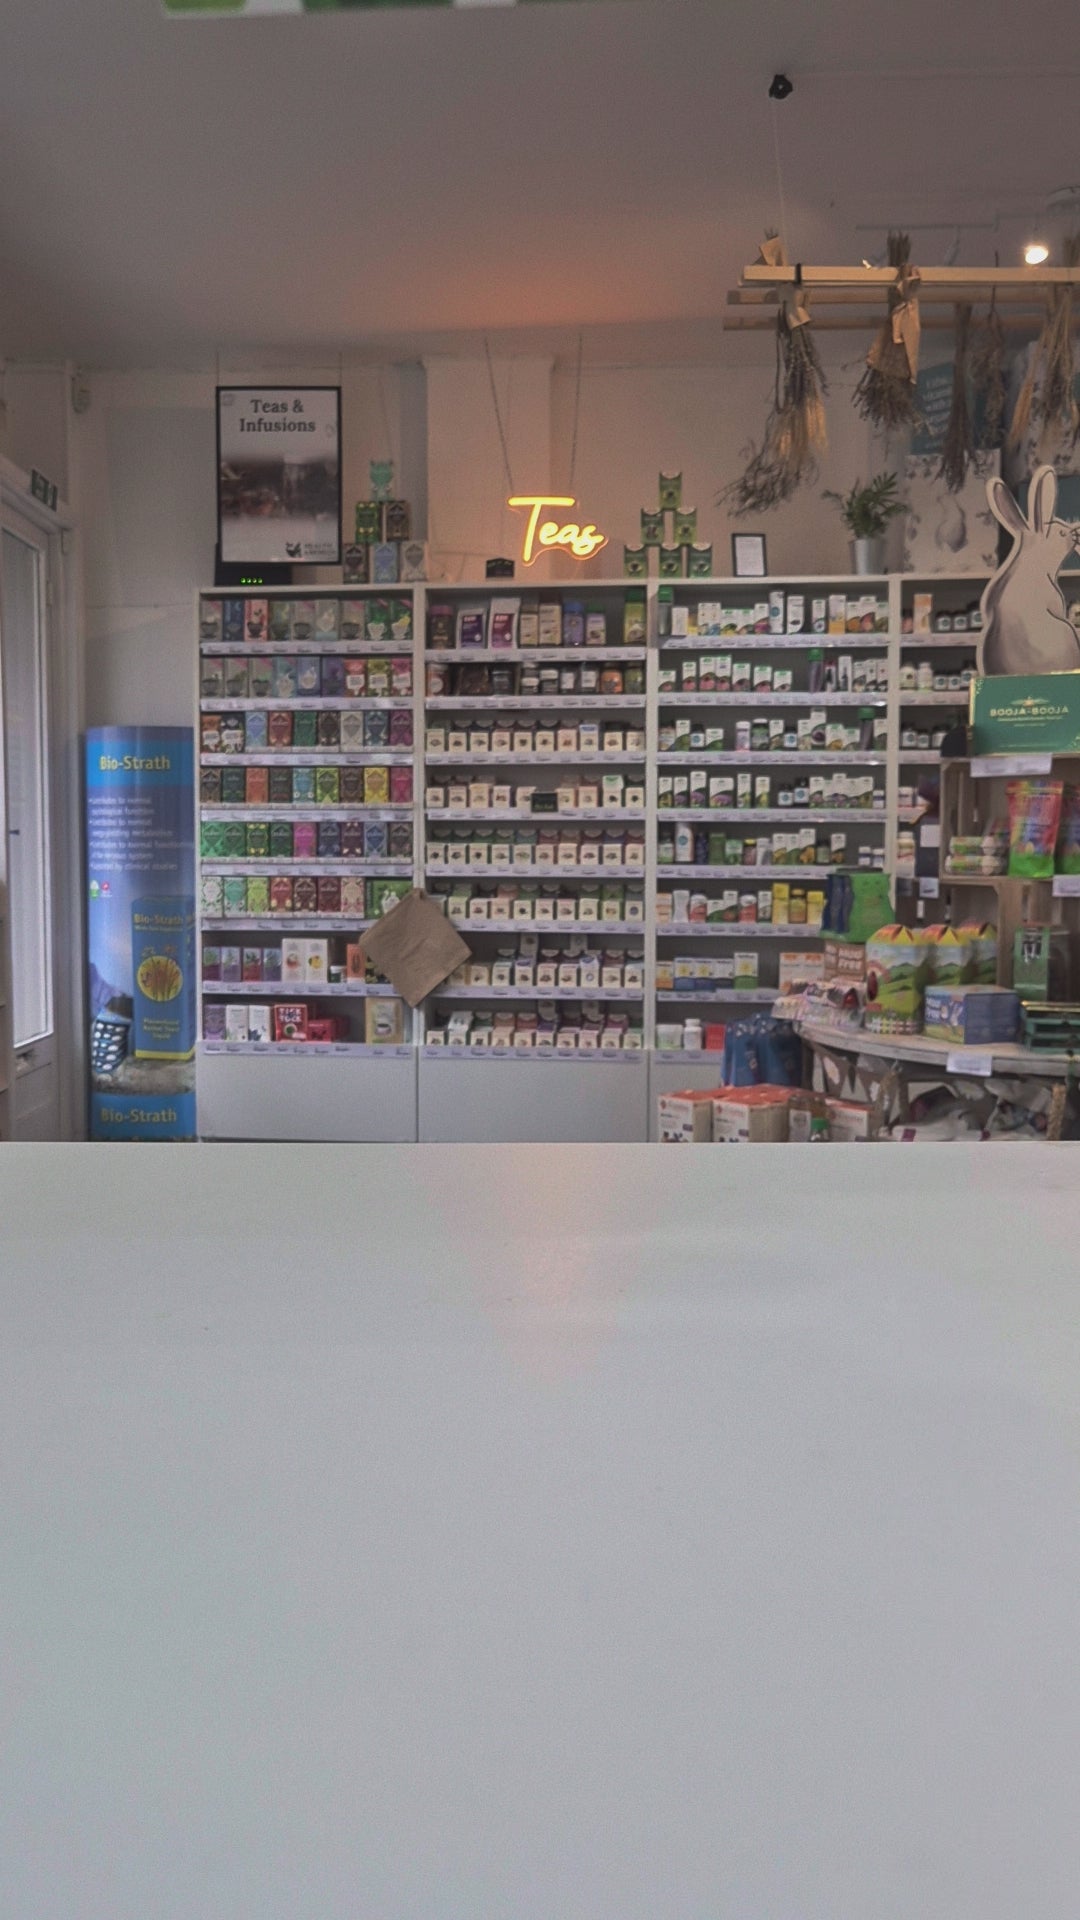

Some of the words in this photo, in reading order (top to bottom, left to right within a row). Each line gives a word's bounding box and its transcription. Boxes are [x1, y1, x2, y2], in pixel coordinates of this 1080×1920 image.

[250, 399, 288, 413] Teas
[292, 399, 304, 413] &
[239, 417, 316, 433] Infusions
[507, 495, 605, 562] Teas
[990, 705, 1069, 717] BOOJA-BOOJA
[99, 755, 171, 772] Bio-Strath
[101, 1107, 177, 1125] Bio-Strath
